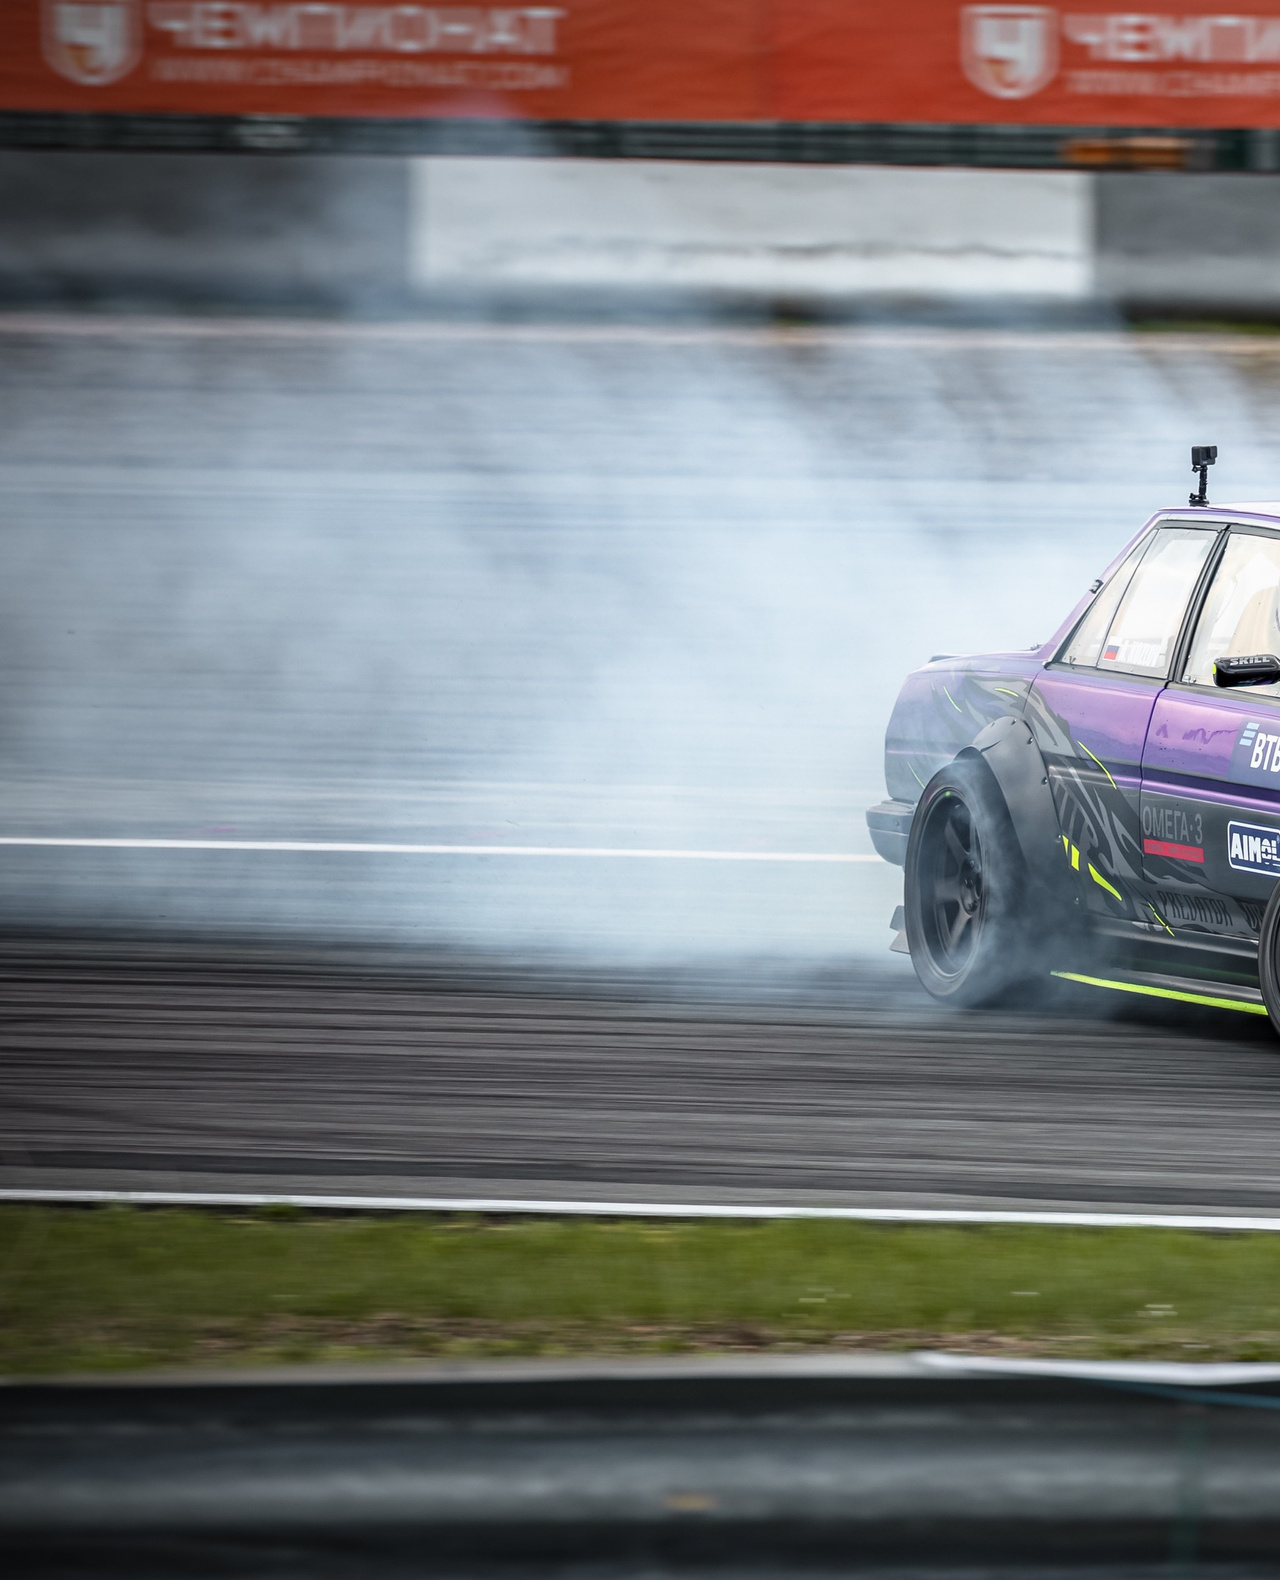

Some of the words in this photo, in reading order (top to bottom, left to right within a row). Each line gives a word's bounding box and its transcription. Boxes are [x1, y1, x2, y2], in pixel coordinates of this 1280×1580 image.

[1229, 656, 1271, 666] SKILL
[1230, 832, 1280, 867] AIMOL
[1157, 891, 1234, 926] PREDATOR
